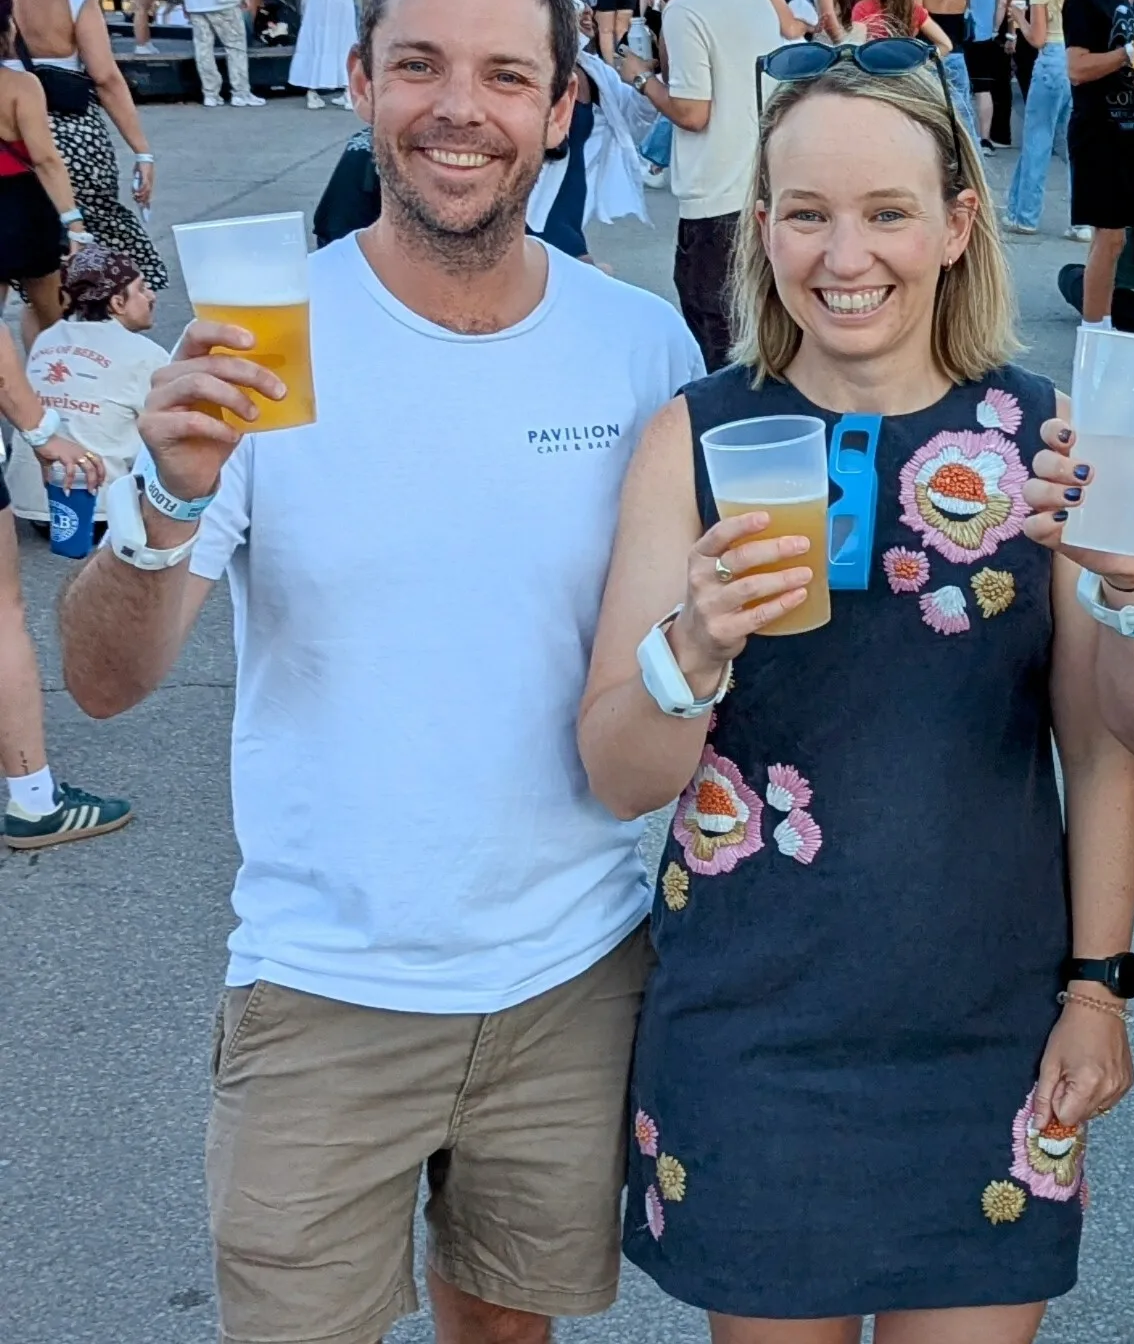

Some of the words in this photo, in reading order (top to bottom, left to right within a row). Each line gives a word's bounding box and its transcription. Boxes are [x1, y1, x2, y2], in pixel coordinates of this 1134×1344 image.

[56, 345, 72, 354] OF
[73, 346, 112, 369] BEERS
[528, 424, 619, 443] PAVILION
[588, 440, 611, 450] BAR
[148, 480, 177, 512] FLOOR
